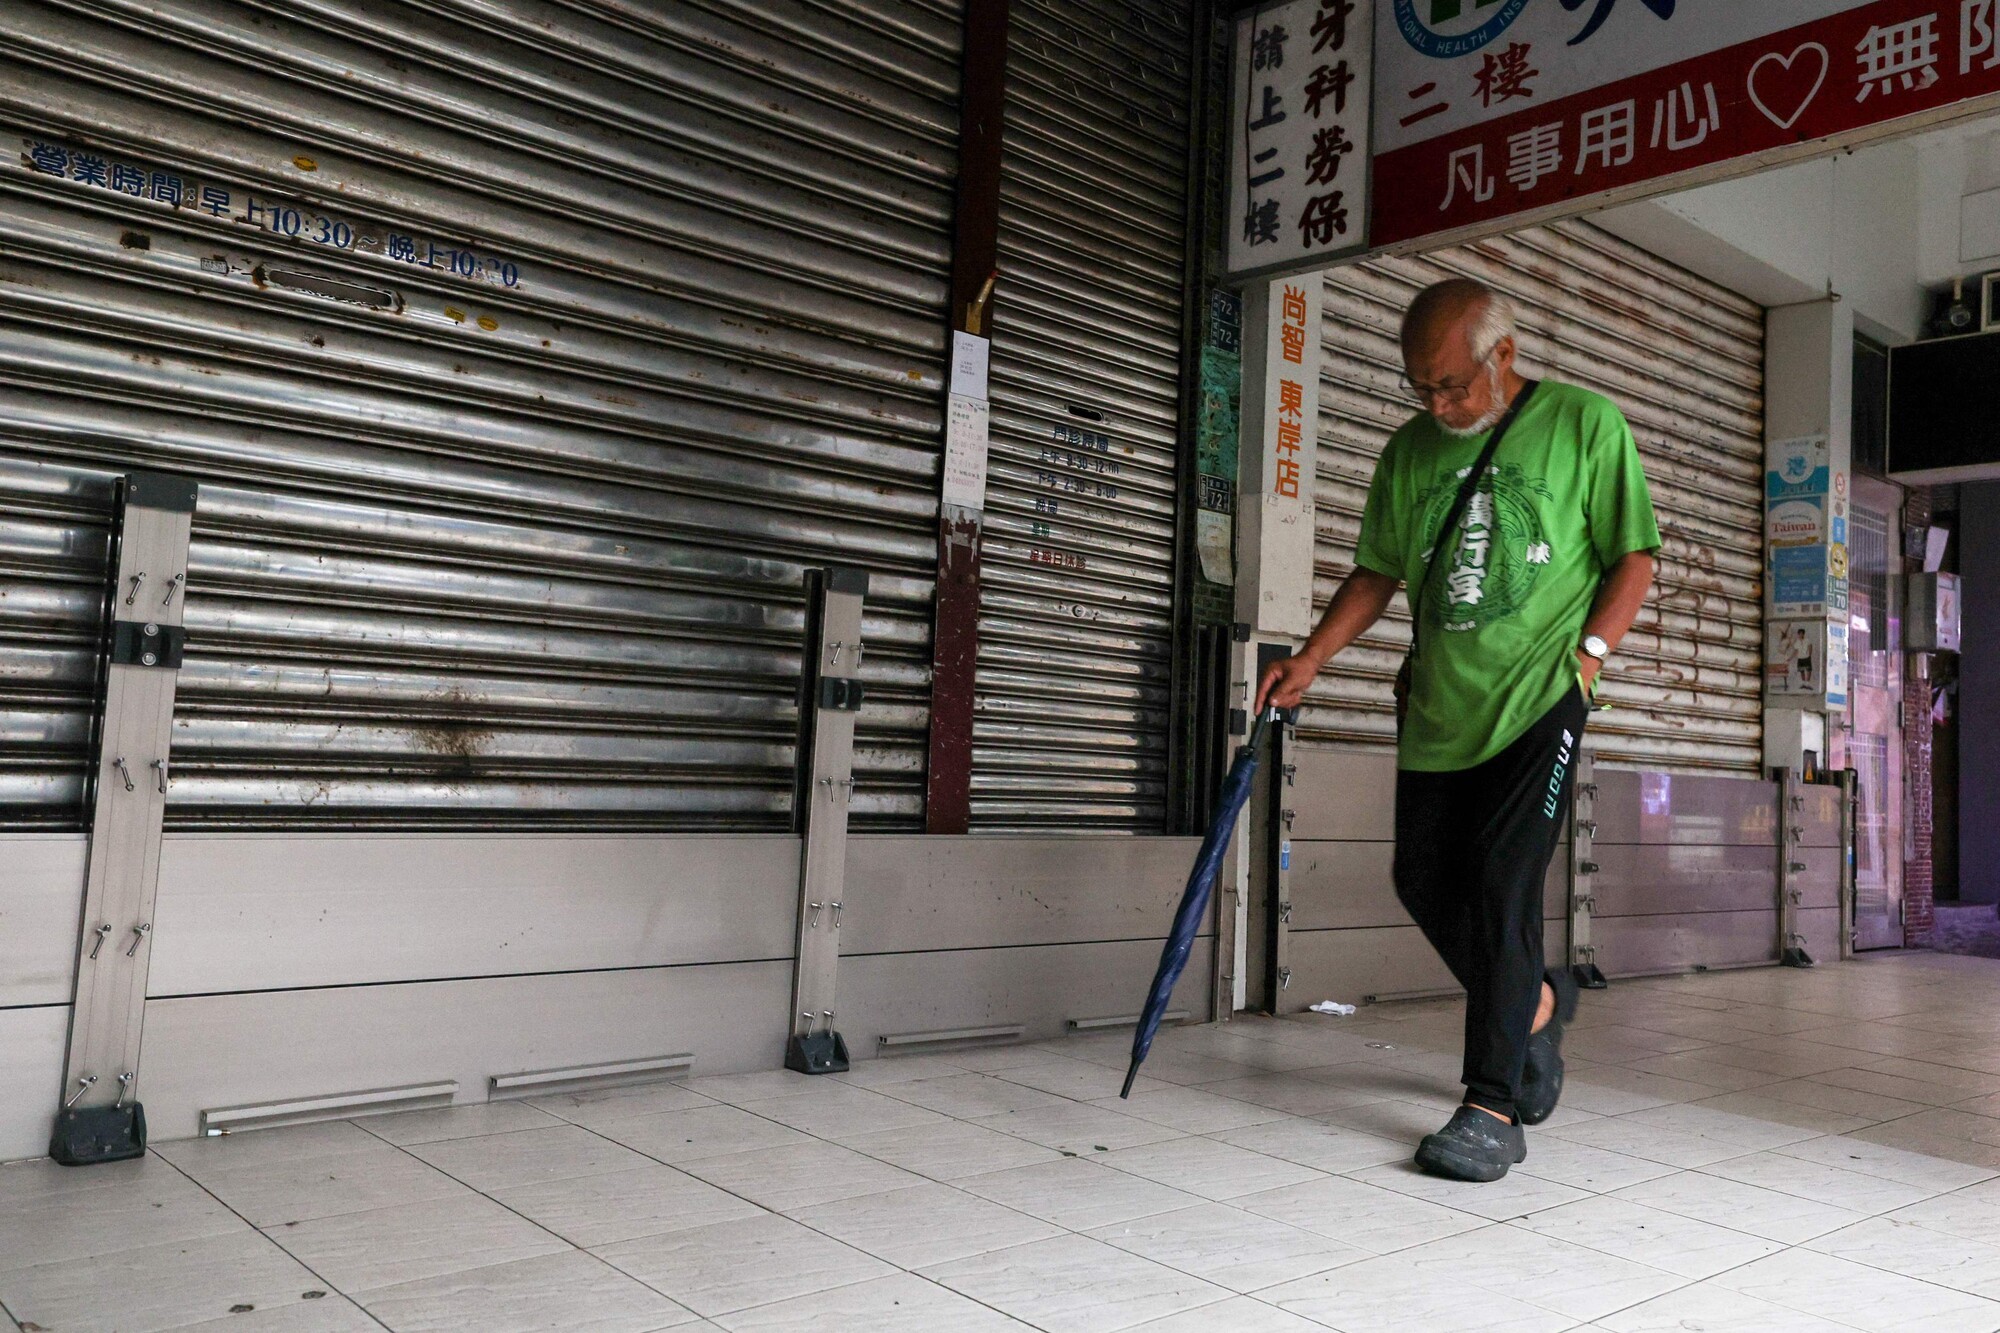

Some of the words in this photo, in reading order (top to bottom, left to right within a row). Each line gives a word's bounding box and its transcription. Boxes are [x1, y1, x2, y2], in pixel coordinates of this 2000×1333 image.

[1436, 32, 1488, 54] HEALTH
[1400, 42, 1539, 128] 二樓
[1299, 0, 1353, 248] 牙科勞保
[1245, 25, 1288, 247] 請上二樓
[1439, 81, 1720, 212] 凡事用心
[1220, 299, 1233, 316] 72
[1281, 284, 1307, 365] 尚智
[1219, 328, 1232, 344] 72
[1274, 378, 1304, 499] 東岸店
[1038, 448, 1060, 464] 上午
[1035, 471, 1058, 488] 下午
[1210, 492, 1223, 507] 72
[1772, 521, 1816, 534] Taiwan
